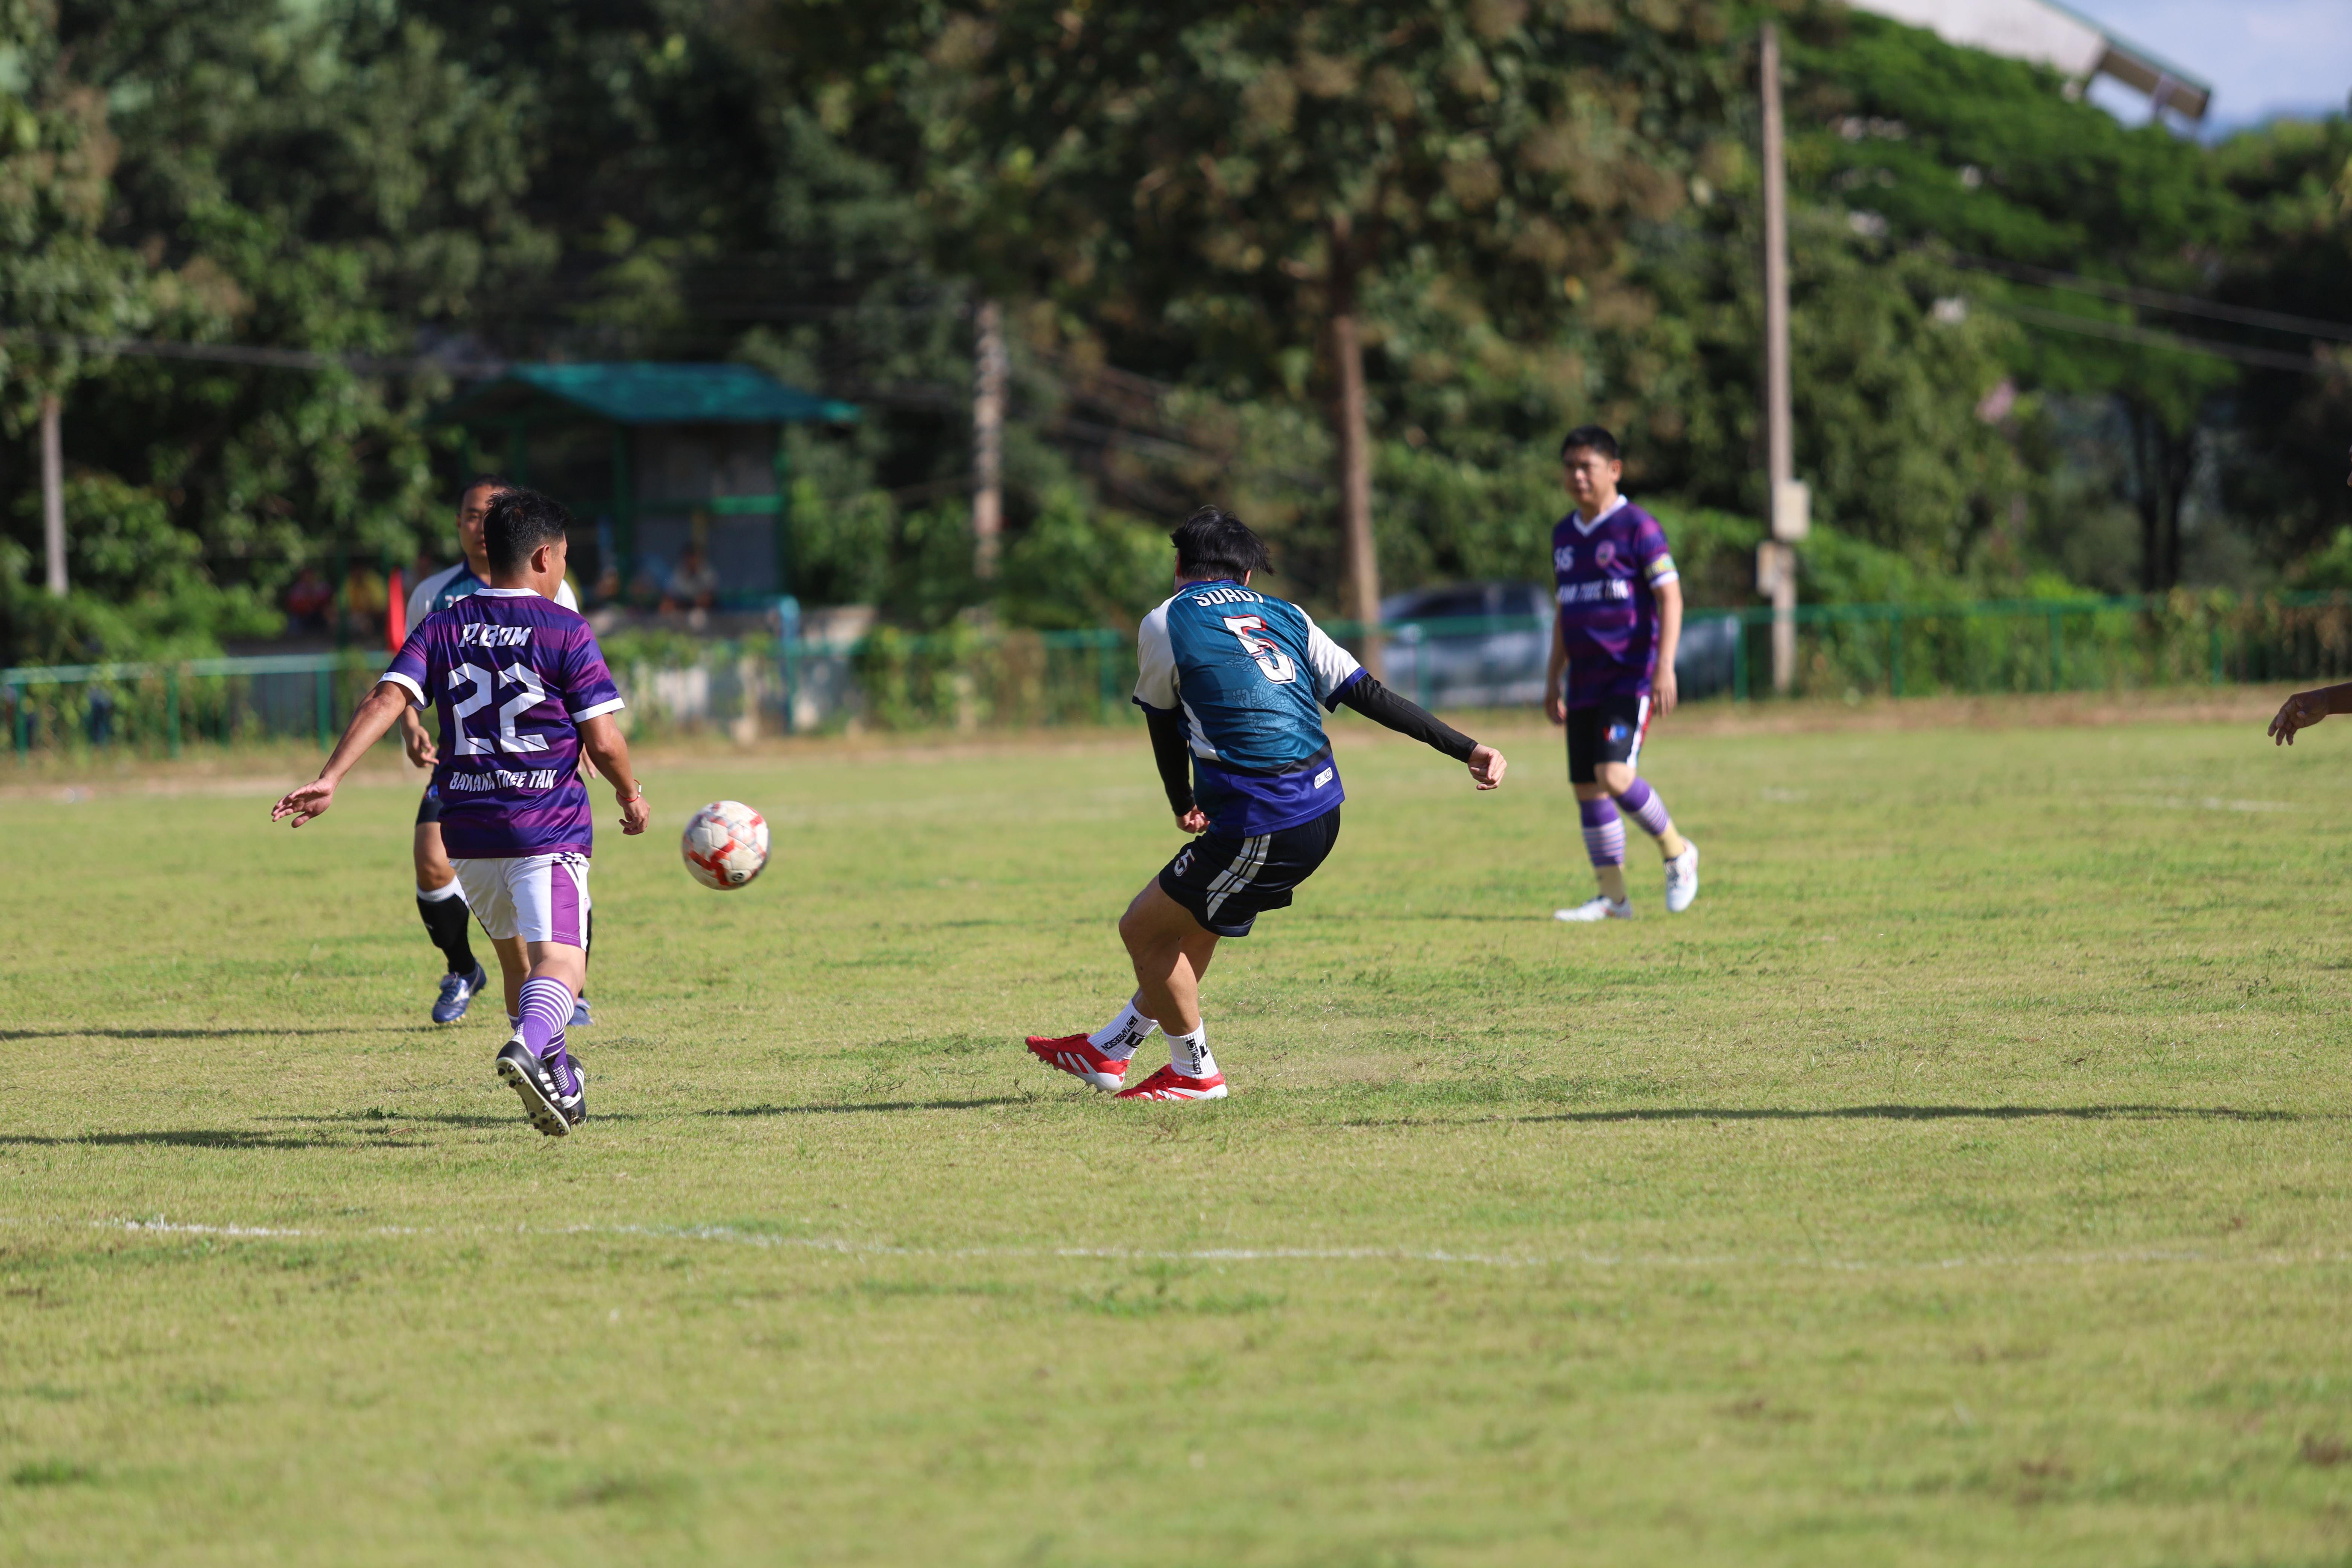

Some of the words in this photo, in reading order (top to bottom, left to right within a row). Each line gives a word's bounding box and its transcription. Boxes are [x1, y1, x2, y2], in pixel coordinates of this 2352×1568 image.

[458, 623, 533, 648] P.BOM
[1222, 614, 1296, 684] 5
[448, 662, 550, 755] 22
[449, 772, 495, 792] BANANA
[495, 769, 527, 788] TREE
[528, 769, 557, 789] TAK
[1173, 848, 1196, 877] 5
